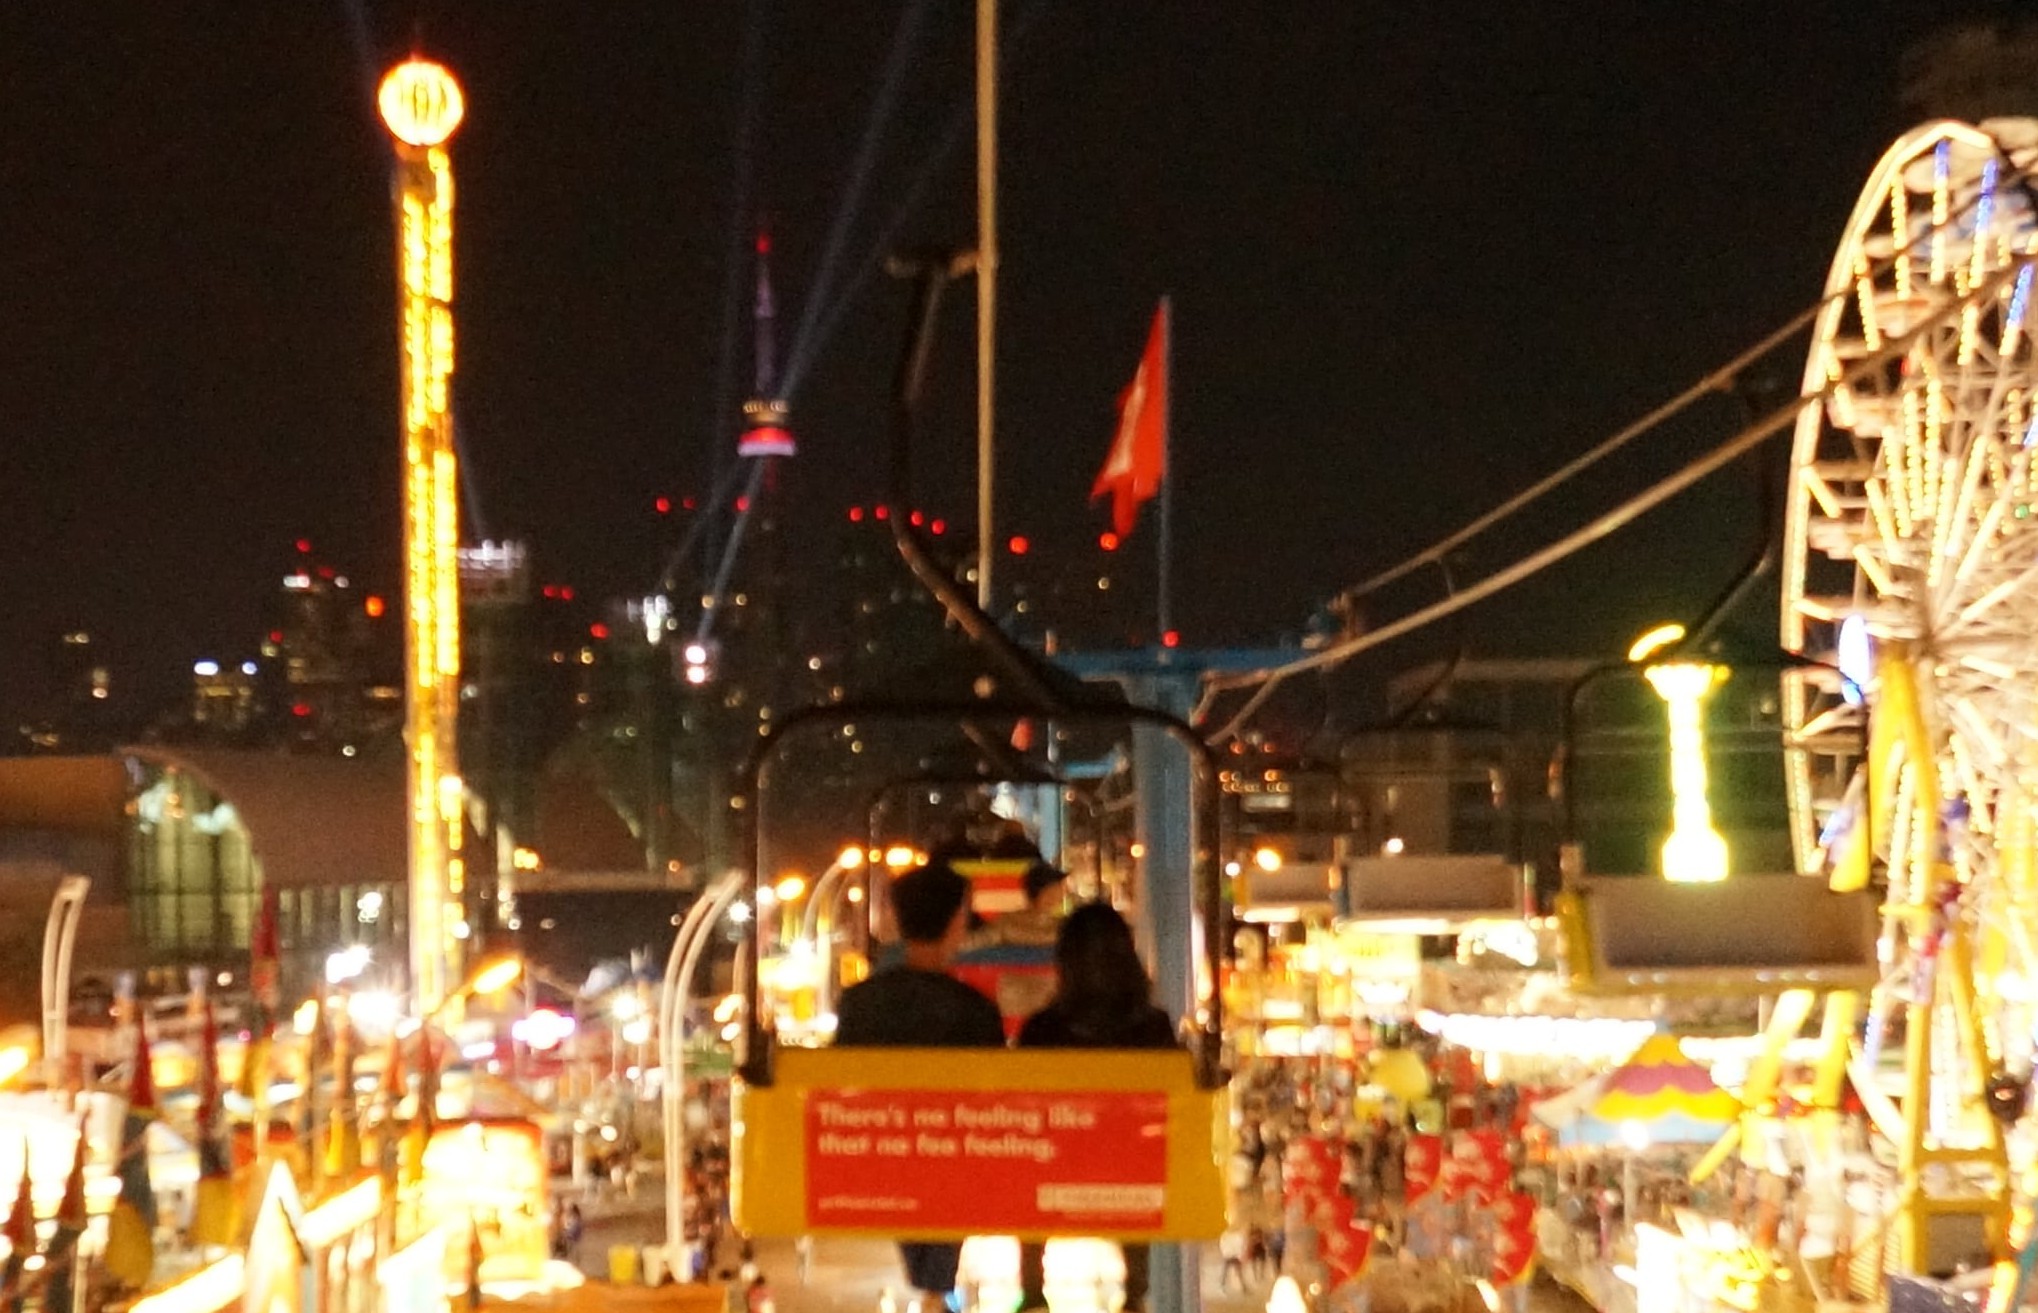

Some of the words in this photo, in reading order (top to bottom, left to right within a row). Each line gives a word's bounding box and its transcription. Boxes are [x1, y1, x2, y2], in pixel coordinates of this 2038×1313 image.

[913, 1108, 947, 1127] no
[954, 1102, 1041, 1133] feeling
[1048, 1102, 1095, 1128] like
[818, 1133, 869, 1155] that
[877, 1136, 909, 1155] no
